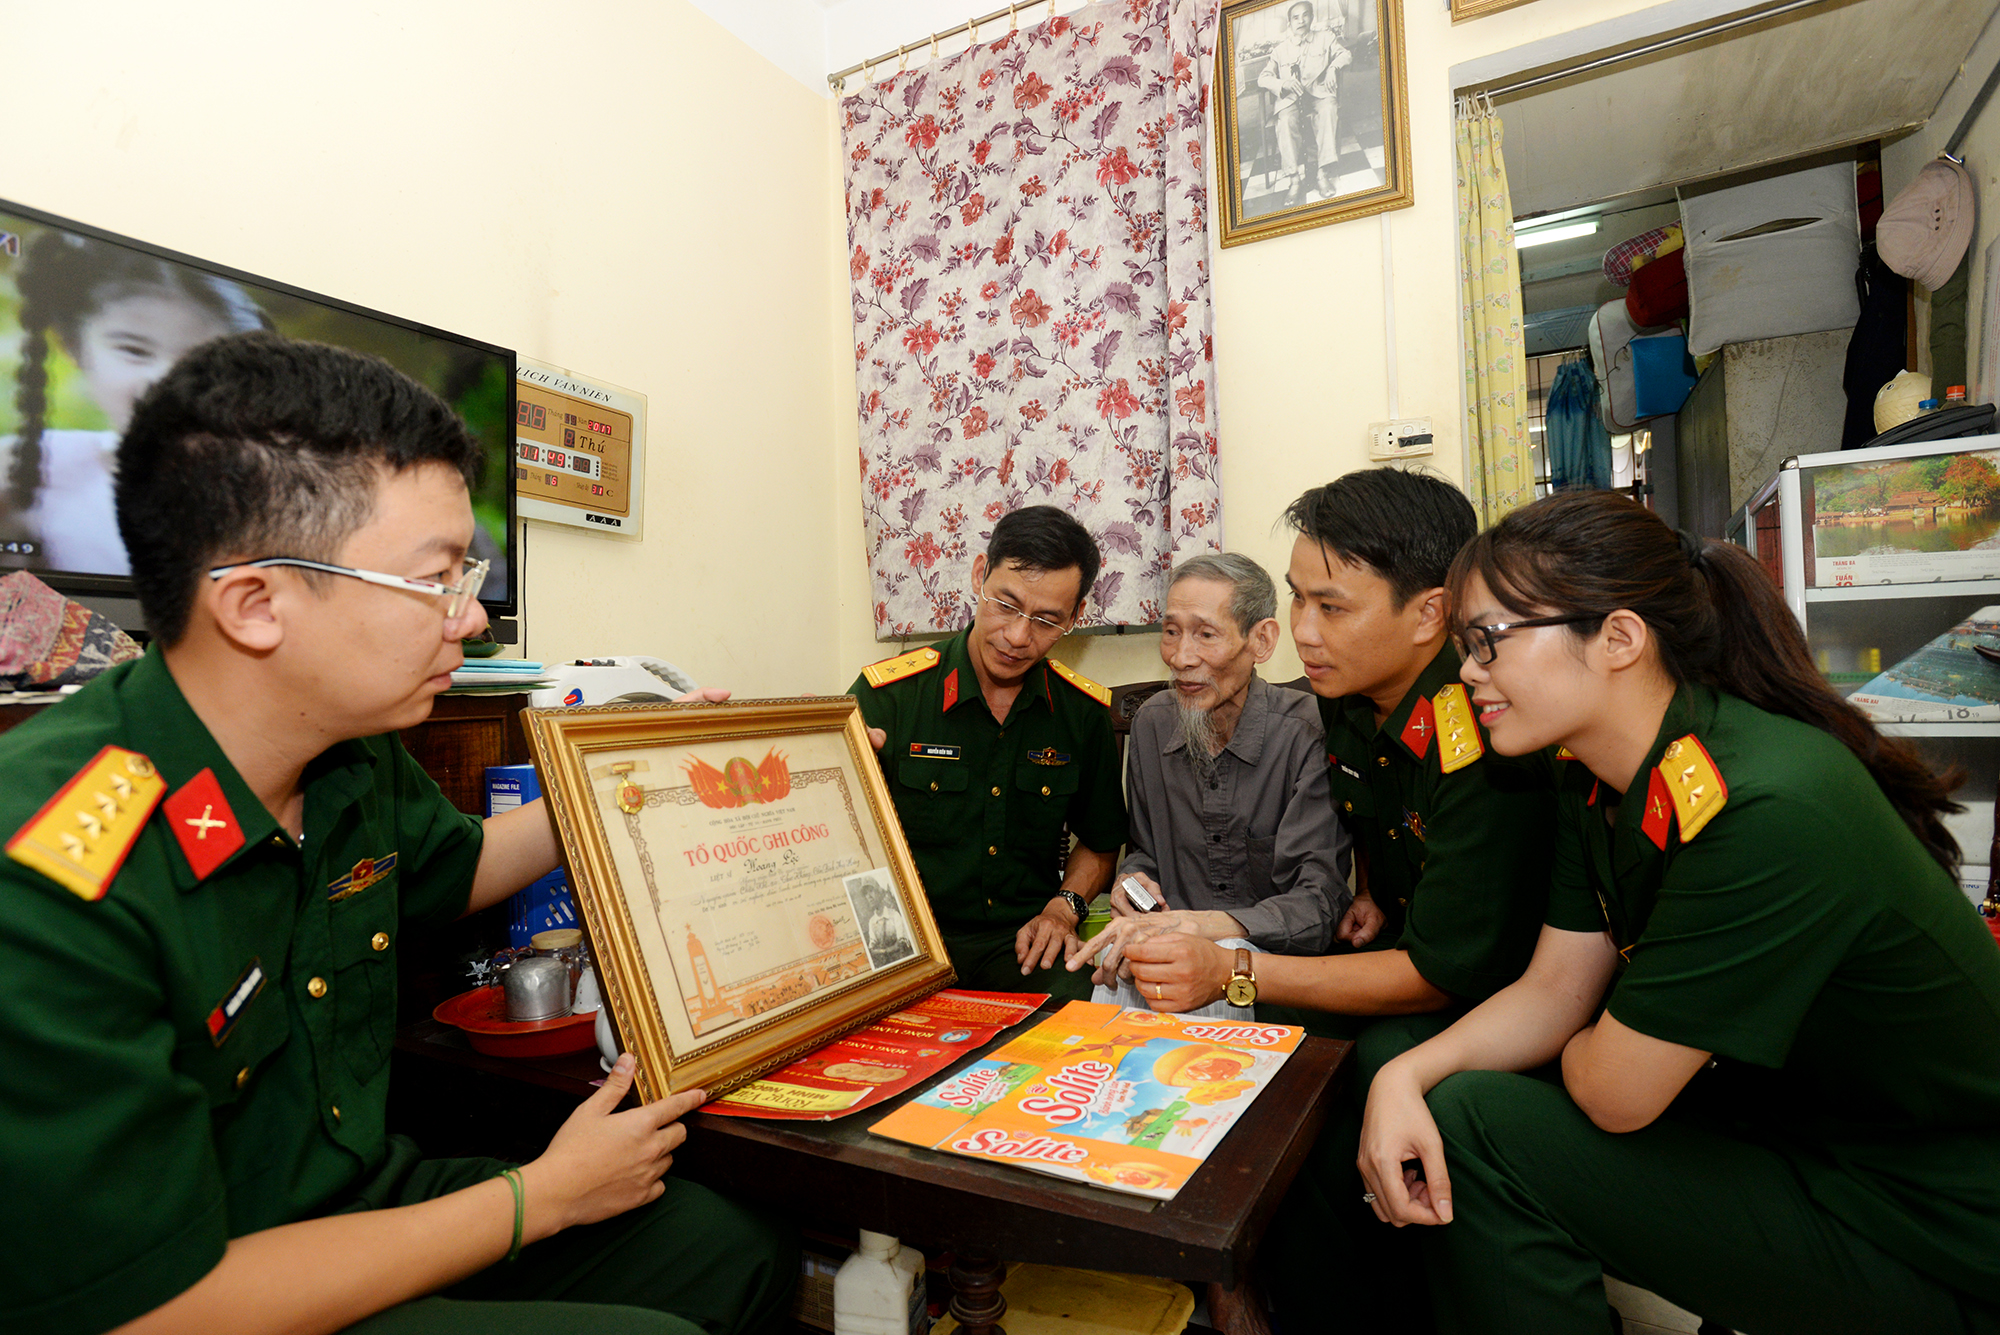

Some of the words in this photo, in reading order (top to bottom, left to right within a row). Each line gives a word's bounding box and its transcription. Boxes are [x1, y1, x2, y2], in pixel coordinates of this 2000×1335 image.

[580, 436, 606, 454] Thứ
[588, 420, 612, 435] 2017
[684, 843, 709, 866] TỔ
[713, 836, 760, 863] QUỐC
[762, 831, 790, 850] GHI
[791, 824, 829, 844] CÔNG
[1182, 1026, 1291, 1046] Solite
[939, 1069, 999, 1108] Solite
[1018, 1061, 1114, 1124] Solite
[952, 1128, 1088, 1163] Solite
